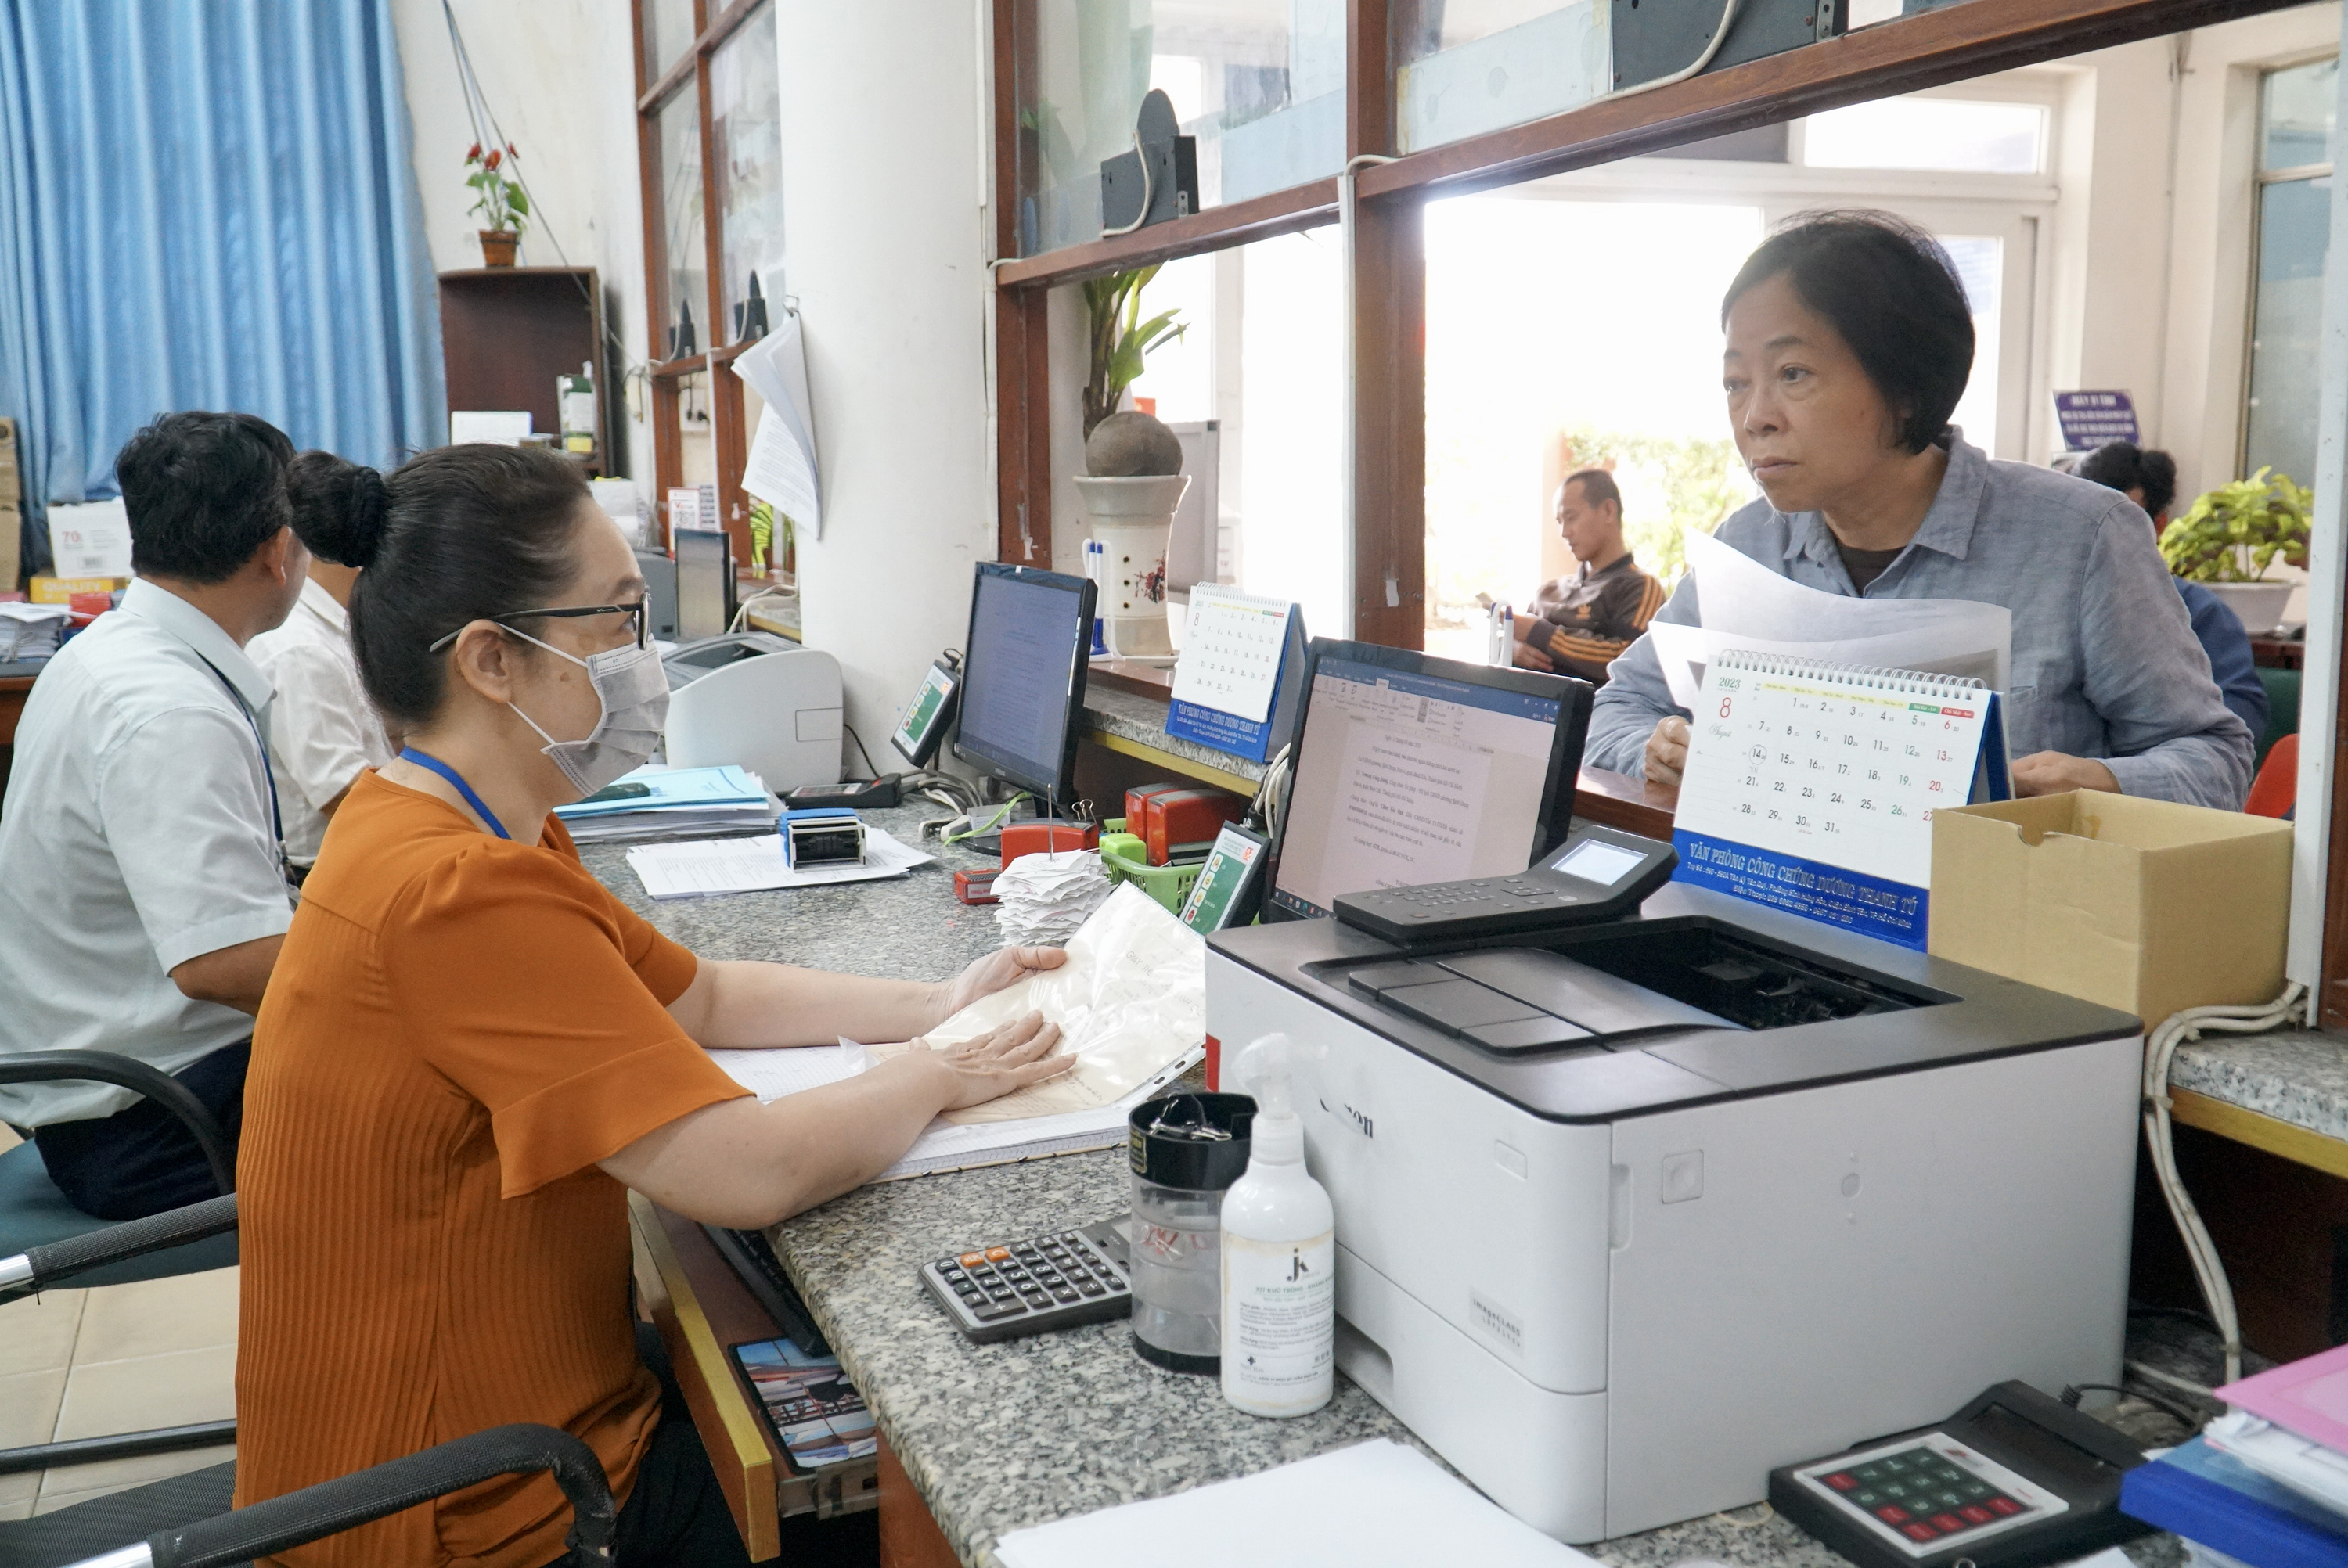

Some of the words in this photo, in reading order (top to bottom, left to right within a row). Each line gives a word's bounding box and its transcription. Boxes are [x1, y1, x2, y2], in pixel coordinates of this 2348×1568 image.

[41, 581, 101, 592] QUALITY
[1194, 612, 1200, 626] 8
[1718, 676, 1741, 689] 2023
[1720, 697, 1731, 718] 8
[1792, 697, 1797, 707] 1
[1820, 702, 1827, 711] 2
[1849, 706, 1856, 716] 3
[1880, 710, 1887, 721] 4
[1911, 715, 1918, 725] 5
[1944, 720, 1950, 730] 6
[1759, 721, 1765, 730] 7
[1787, 725, 1792, 735] 8
[1816, 730, 1821, 739] 9
[1843, 735, 1853, 746] 10
[1874, 739, 1883, 750] 11
[1905, 744, 1915, 756] 12
[1936, 750, 1947, 761] 13
[1752, 748, 1762, 758] 14
[1781, 753, 1789, 764] 15
[1809, 758, 1818, 769] 16
[1838, 764, 1848, 775] 17
[1868, 769, 1878, 780] 18
[1899, 775, 1909, 786] 19
[1929, 780, 1941, 792] 20
[1746, 775, 1756, 786] 21
[1774, 781, 1784, 792] 22
[1802, 786, 1813, 797] 23
[1831, 793, 1842, 804] 24
[1860, 798, 1871, 810] 25
[1891, 804, 1903, 816] 26
[1922, 811, 1933, 822] 27
[1741, 804, 1752, 814] 28
[1768, 809, 1779, 820] 29
[1795, 815, 1806, 826] 30
[1824, 822, 1835, 833] 31
[1690, 841, 1711, 861] VĂN
[1710, 848, 1745, 870] PHÒNG
[1747, 856, 1776, 879] CÔNG
[1777, 865, 1815, 889] CHỨNG
[1858, 886, 1899, 911] THANH
[949, 1270, 965, 1281] 00
[1473, 1298, 1520, 1337] imageCLASS
